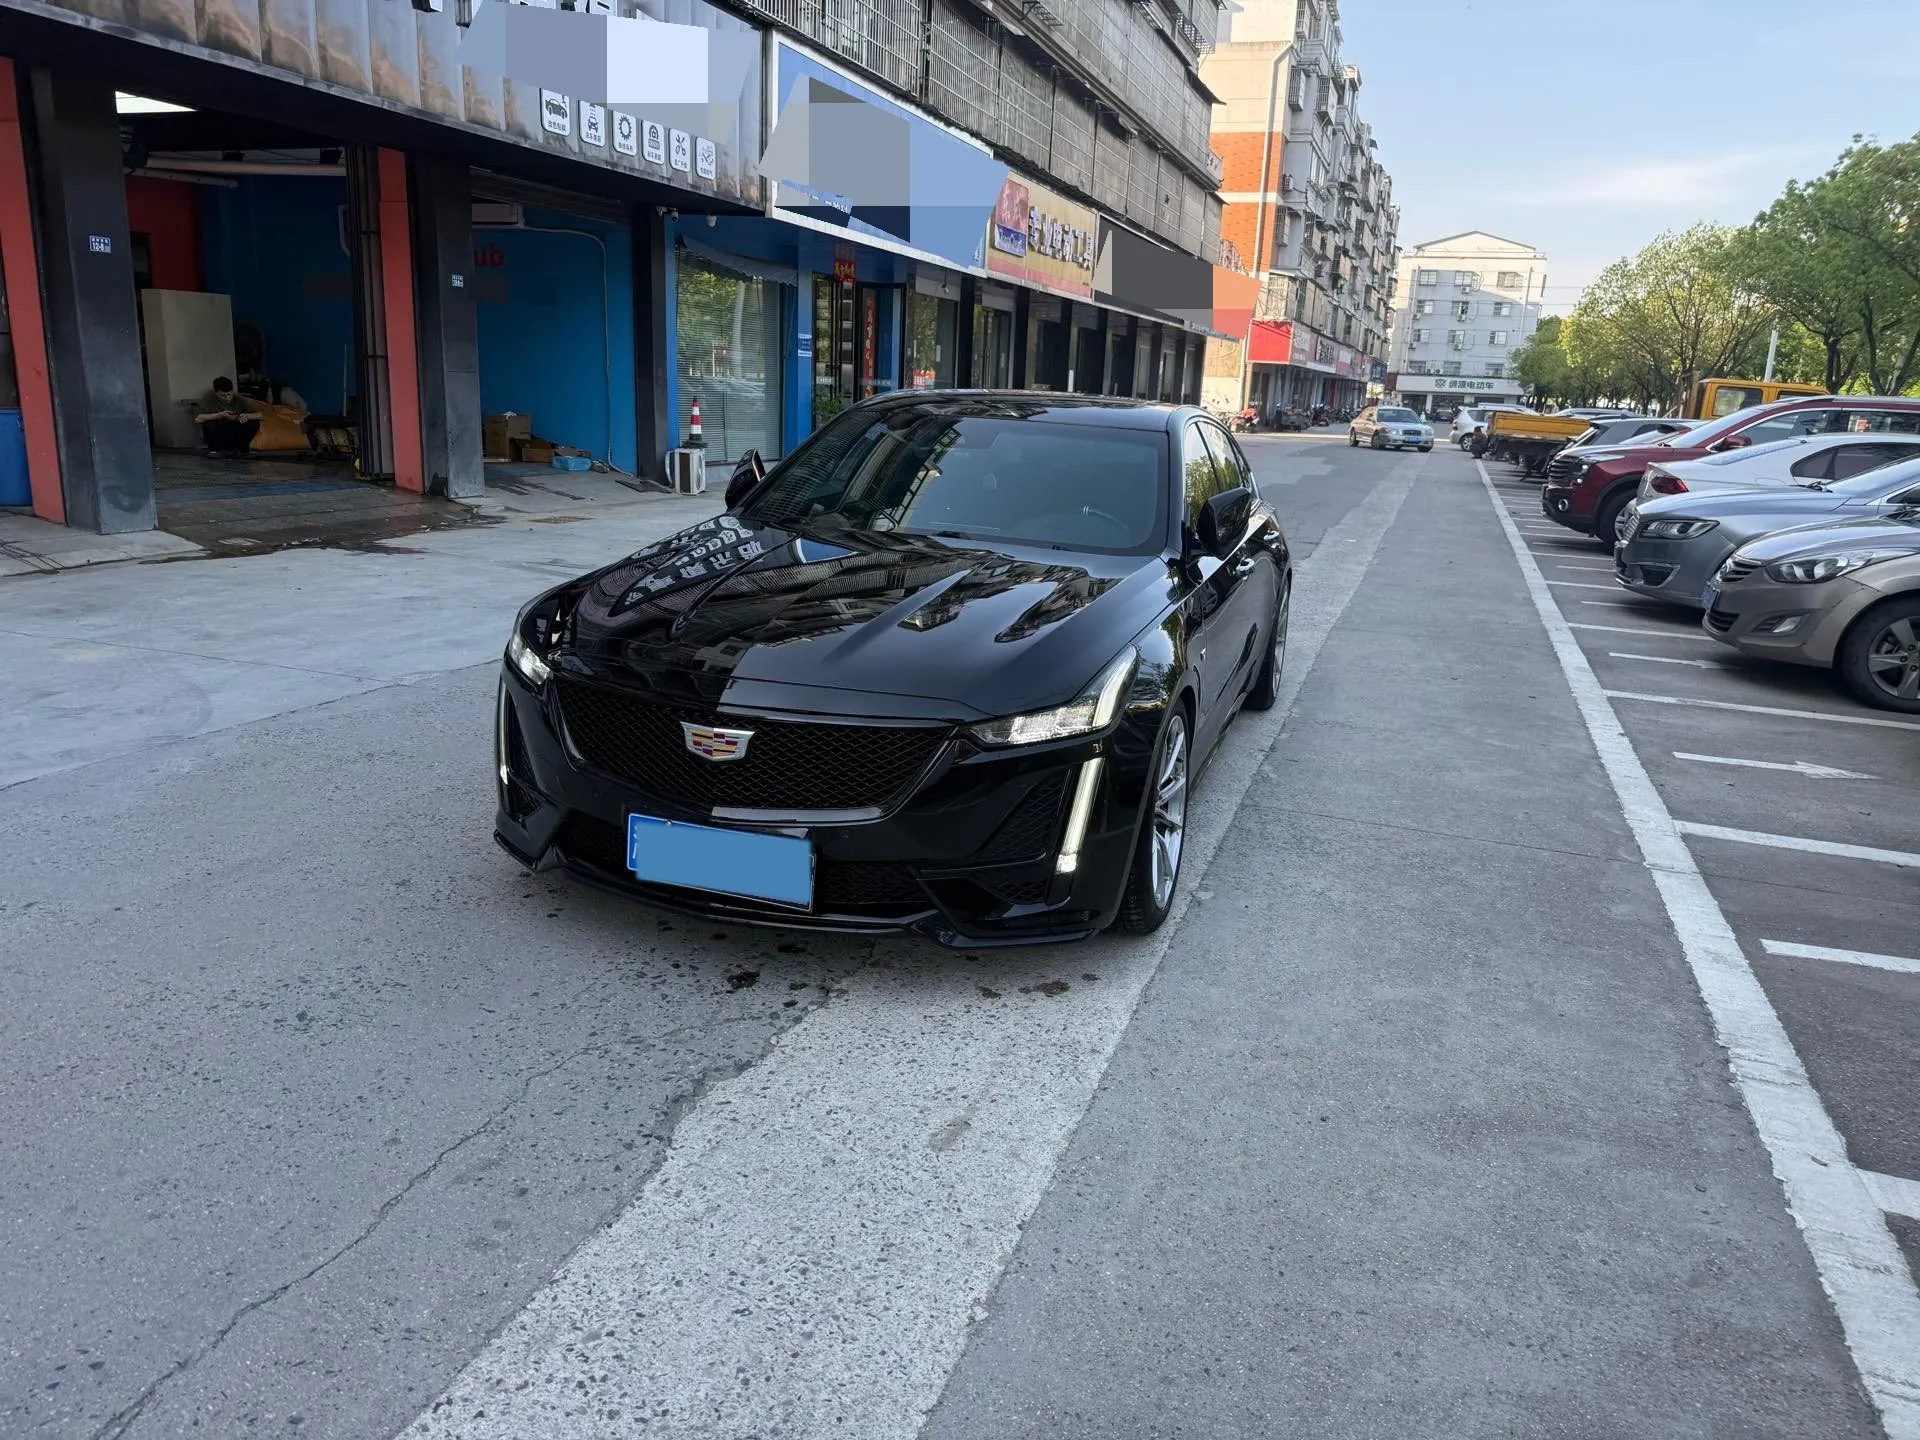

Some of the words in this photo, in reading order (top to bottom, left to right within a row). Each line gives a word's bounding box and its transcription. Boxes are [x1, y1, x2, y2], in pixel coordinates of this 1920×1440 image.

[1028, 205, 1092, 271] 专业电动工具
